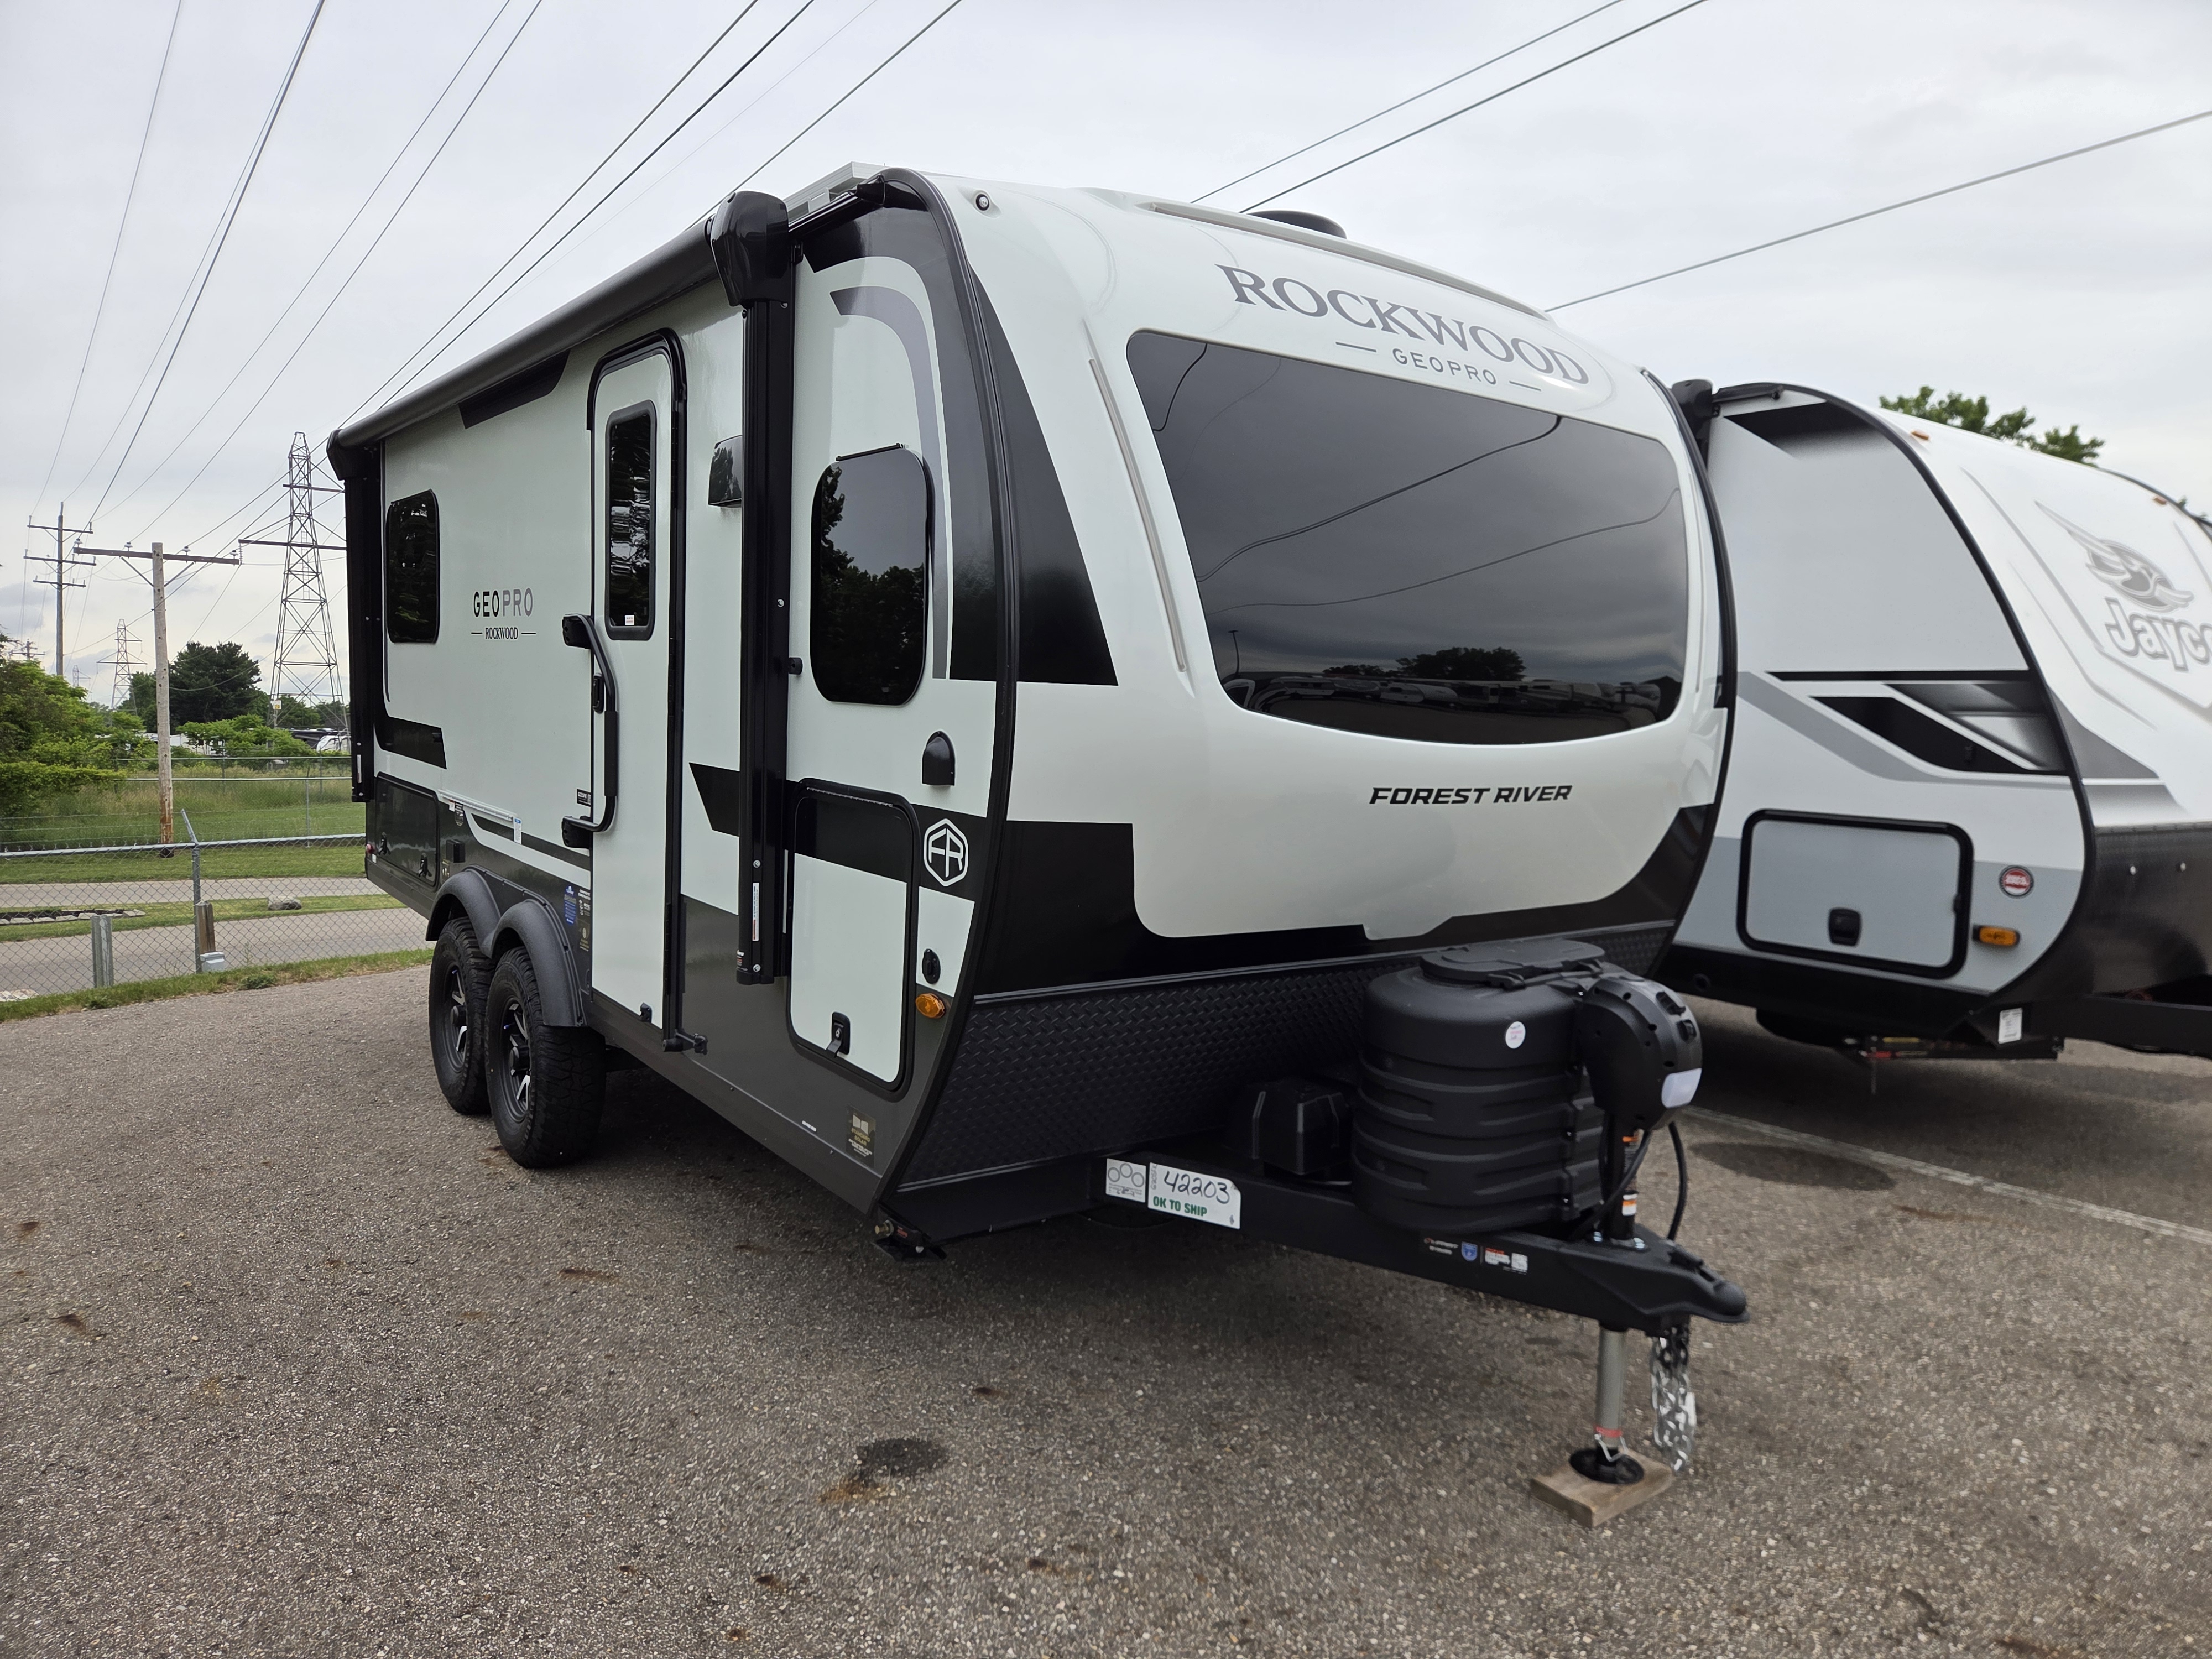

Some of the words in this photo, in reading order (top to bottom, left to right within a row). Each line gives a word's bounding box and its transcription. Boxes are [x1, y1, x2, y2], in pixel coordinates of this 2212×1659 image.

[1215, 264, 1589, 384] ROCKWOOD
[1392, 348, 1496, 385] GEOPRO
[485, 627, 519, 640] ROCKWOOD
[1369, 787, 1491, 805] FOREST
[1493, 785, 1573, 804] RIVER
[1164, 1170, 1230, 1204] 42203
[1153, 1196, 1166, 1208] OK
[1169, 1199, 1181, 1212] TO
[1184, 1203, 1207, 1217] SHIP
